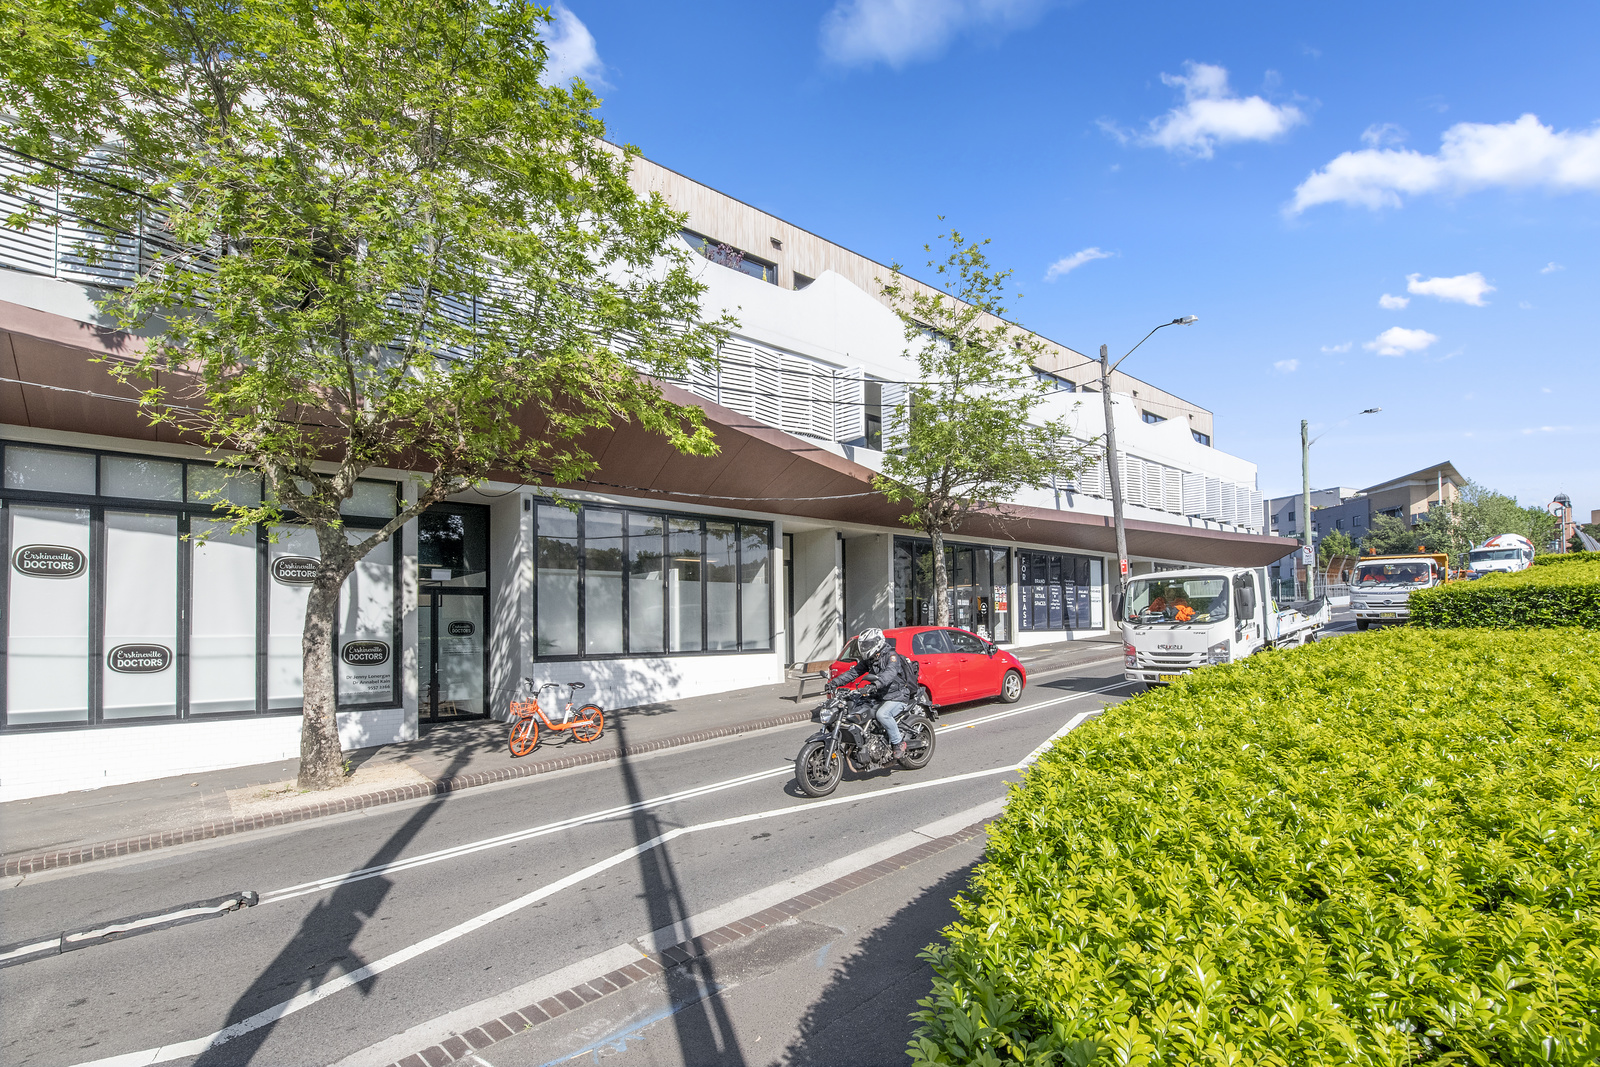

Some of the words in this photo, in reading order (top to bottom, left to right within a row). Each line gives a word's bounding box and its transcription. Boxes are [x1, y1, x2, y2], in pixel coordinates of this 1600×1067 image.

[23, 550, 74, 560] Erskineville
[23, 560, 74, 570] DOCTORS
[117, 650, 162, 659] Erskineville
[117, 659, 163, 667] DOCTORS
